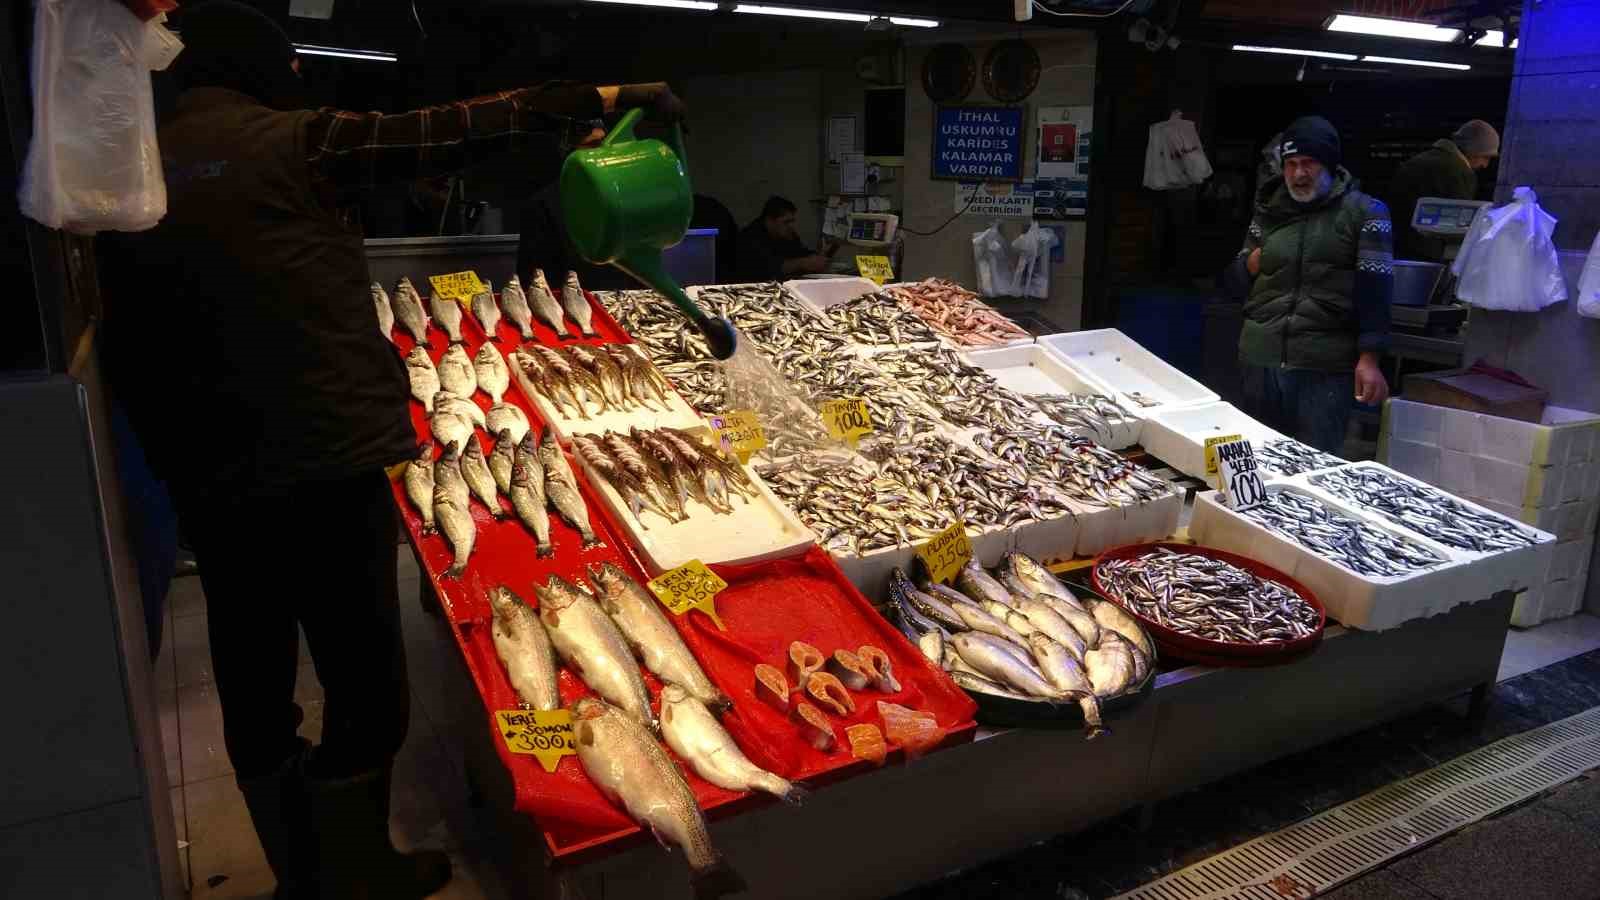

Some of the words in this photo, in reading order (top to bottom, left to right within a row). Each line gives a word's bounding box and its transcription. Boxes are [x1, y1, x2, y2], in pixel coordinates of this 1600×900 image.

[941, 124, 1016, 136] USKUMRU
[941, 151, 1015, 163] KALAMAR
[949, 163, 1003, 175] VARDIR
